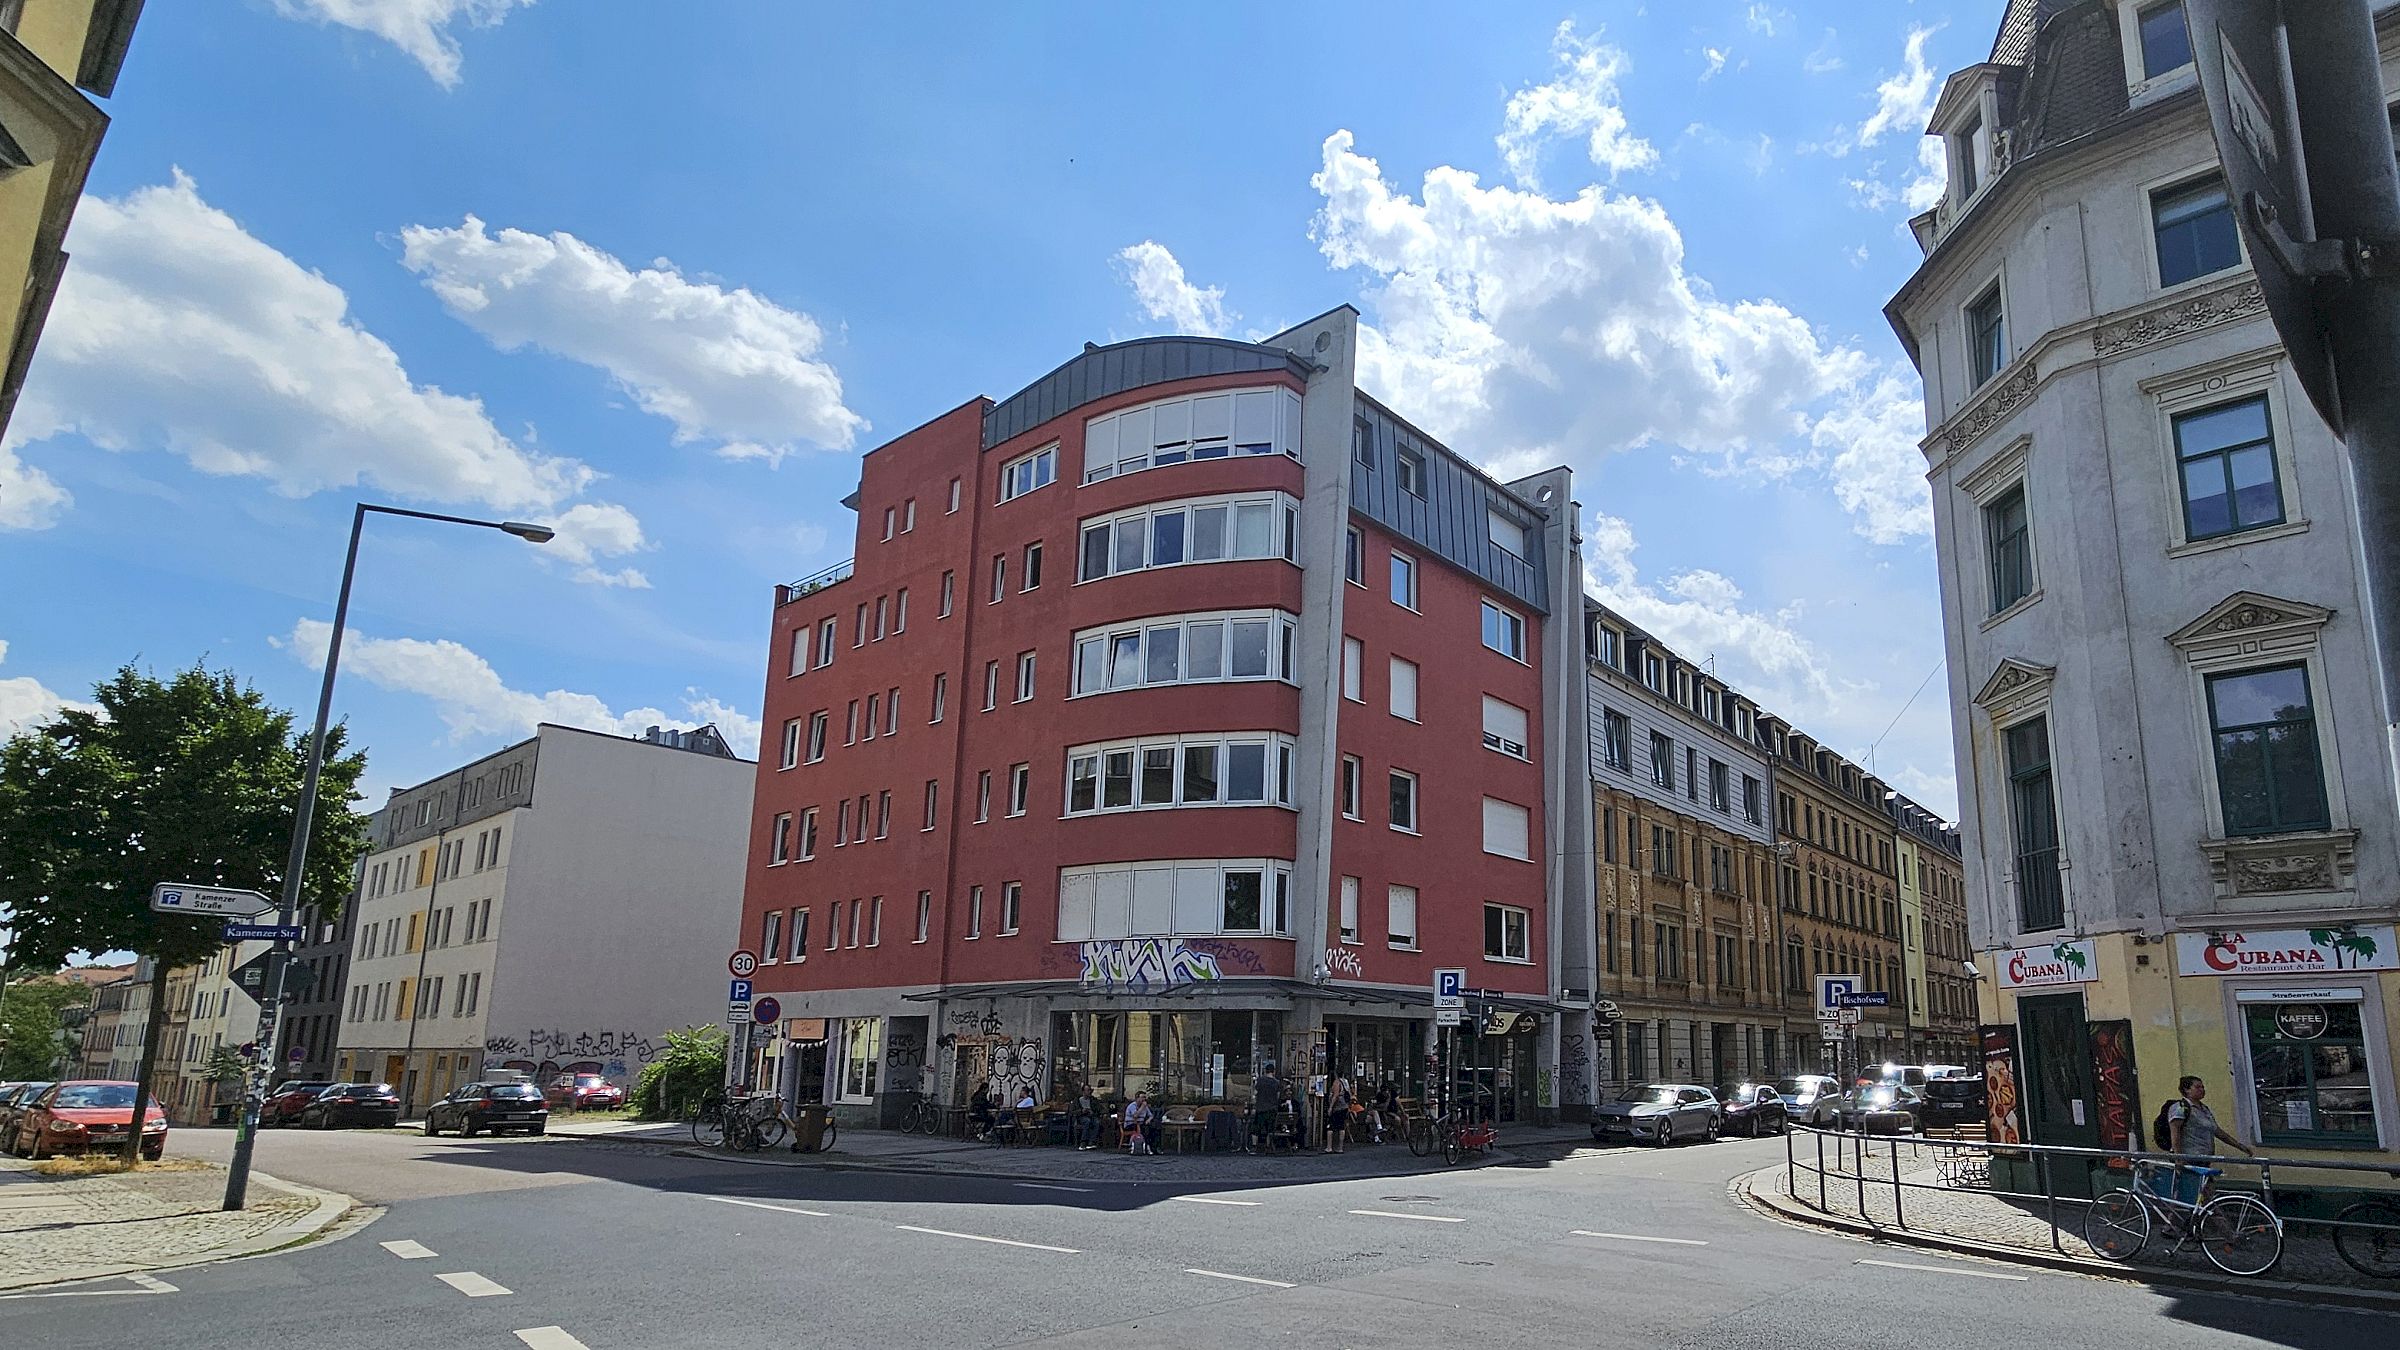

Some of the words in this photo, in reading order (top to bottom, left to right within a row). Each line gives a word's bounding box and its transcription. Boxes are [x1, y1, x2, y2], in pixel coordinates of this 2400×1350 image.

[194, 893, 236, 903] Kamenzer
[194, 901, 222, 910] Straße
[227, 927, 277, 937] Kamenzer
[2221, 932, 2247, 944] LA
[2015, 950, 2027, 960] LA
[2203, 943, 2325, 971] CUBANA
[734, 957, 753, 971] 30
[2240, 964, 2294, 973] Restaurant
[2296, 963, 2304, 971] &
[2008, 957, 2065, 984] CUBANA
[1444, 975, 1455, 994] P
[735, 982, 748, 998] P
[2272, 991, 2331, 999] Straßenverkauf
[1440, 998, 1457, 1006] ZONE
[1843, 996, 1885, 1004] Bischofsweg
[2280, 1014, 2322, 1023] KAFFEE
[2102, 1045, 2129, 1144] TAPAS
